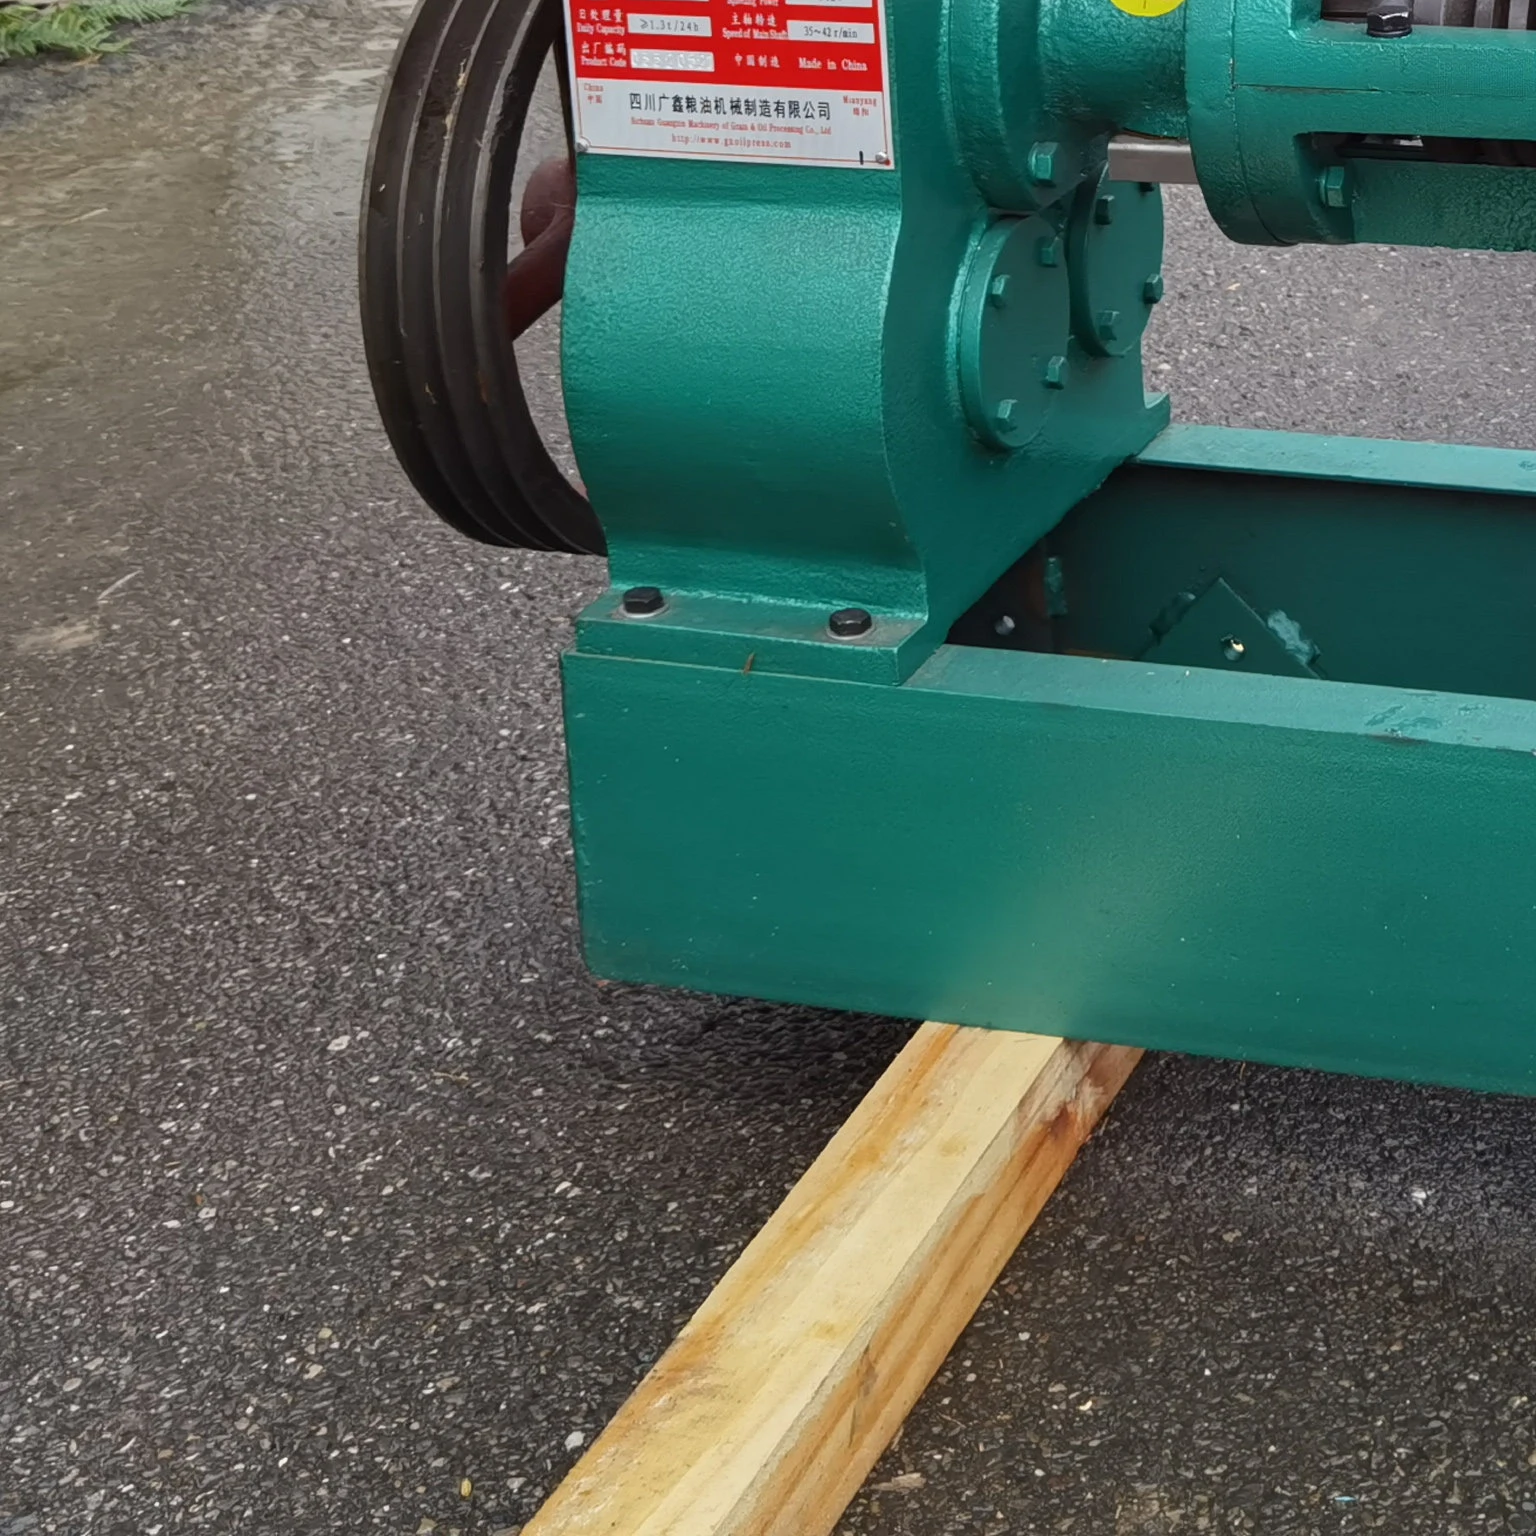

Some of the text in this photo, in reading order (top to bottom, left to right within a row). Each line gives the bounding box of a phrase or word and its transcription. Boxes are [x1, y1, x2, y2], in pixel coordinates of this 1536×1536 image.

[734, 53, 781, 68] 中国制造
[798, 57, 868, 71] Made in China
[629, 92, 831, 120] 四川广鑫粮油机械制造有限公司
